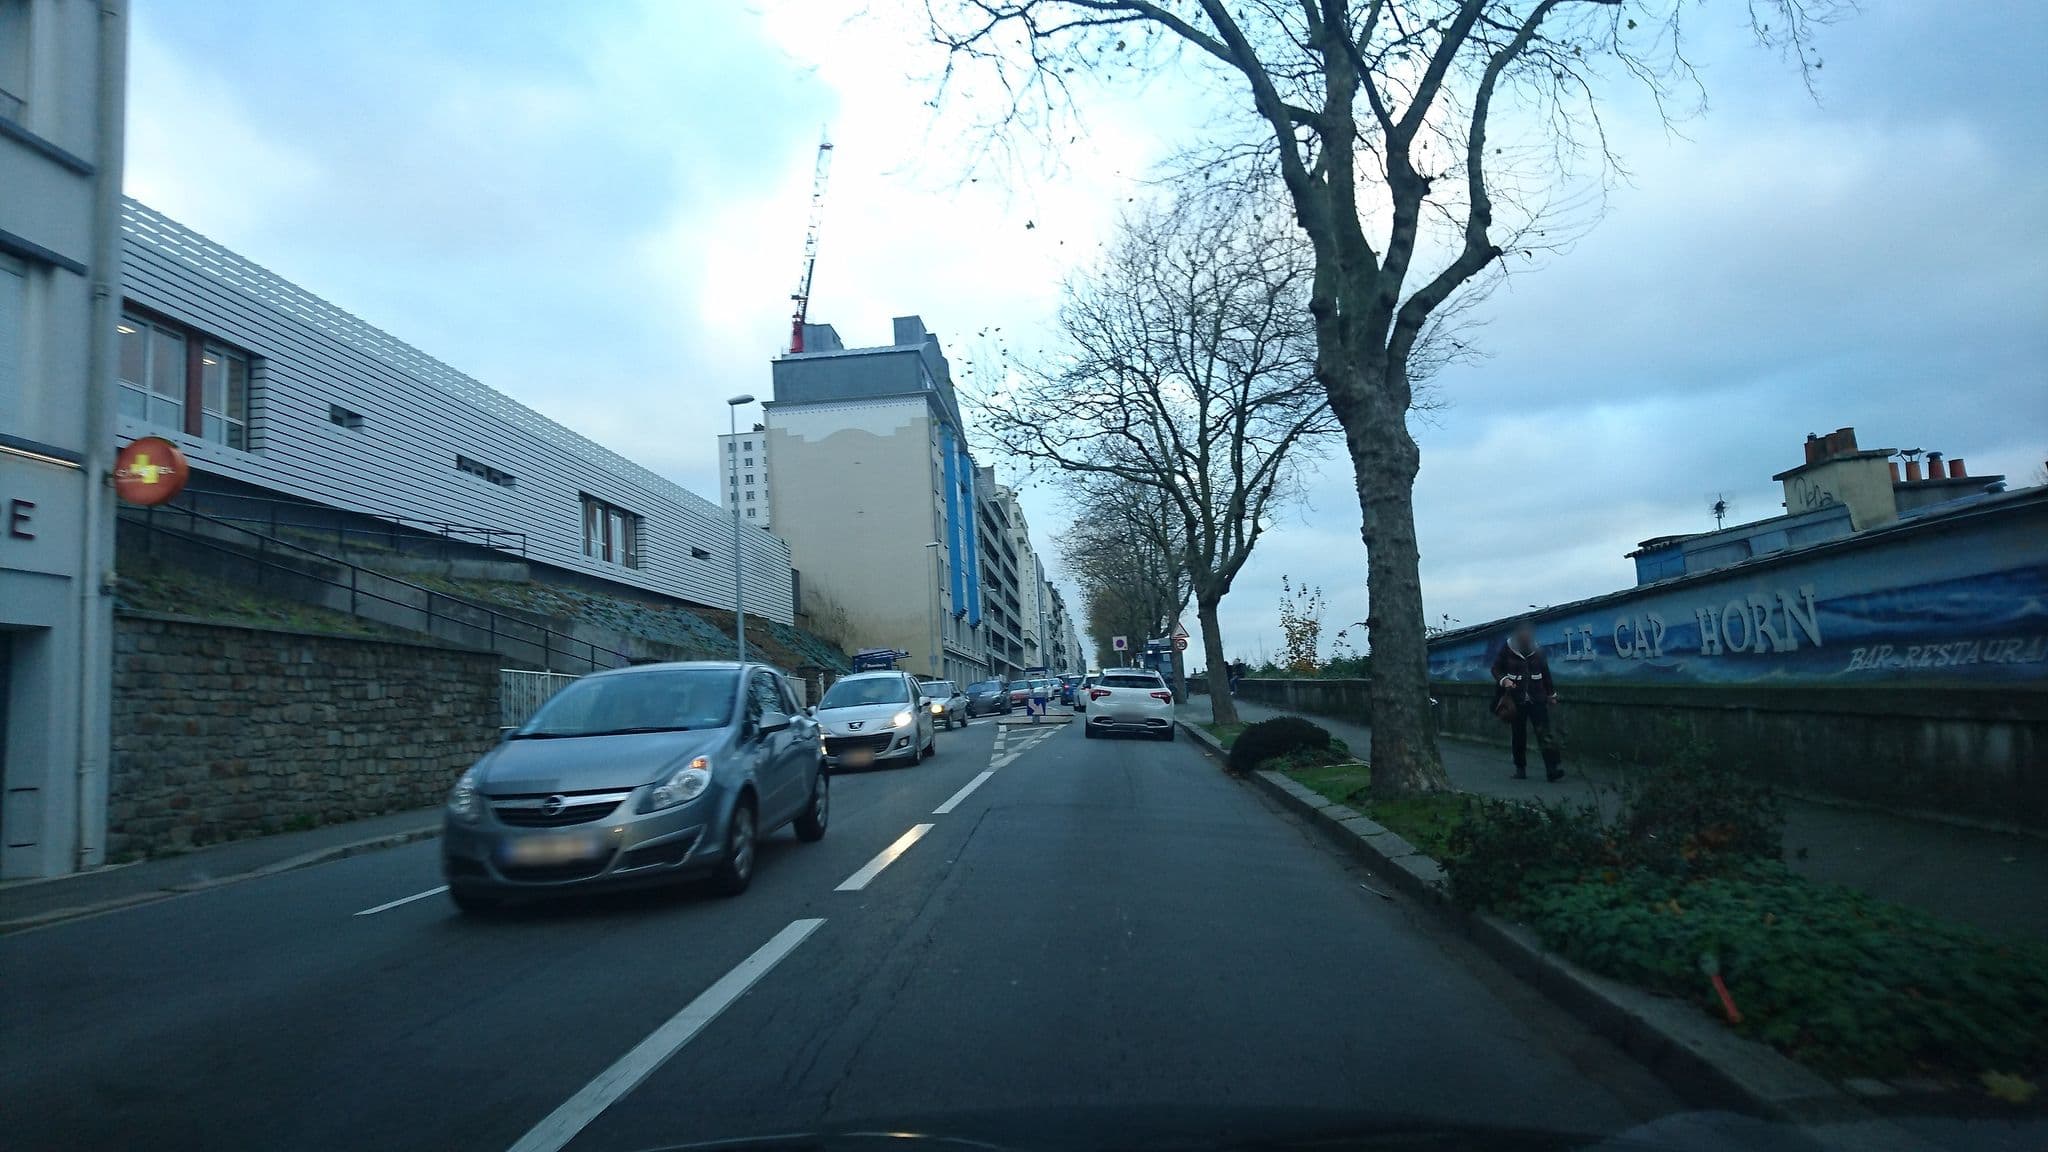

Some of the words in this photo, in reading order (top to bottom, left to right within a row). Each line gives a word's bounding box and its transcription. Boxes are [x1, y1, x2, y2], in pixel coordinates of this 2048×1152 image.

[0, 497, 36, 541] E
[1563, 623, 1598, 662] LE
[1613, 612, 1666, 660] CAP
[1696, 583, 1822, 656] HORN
[1848, 636, 2048, 671] BAR-RESTAURA
